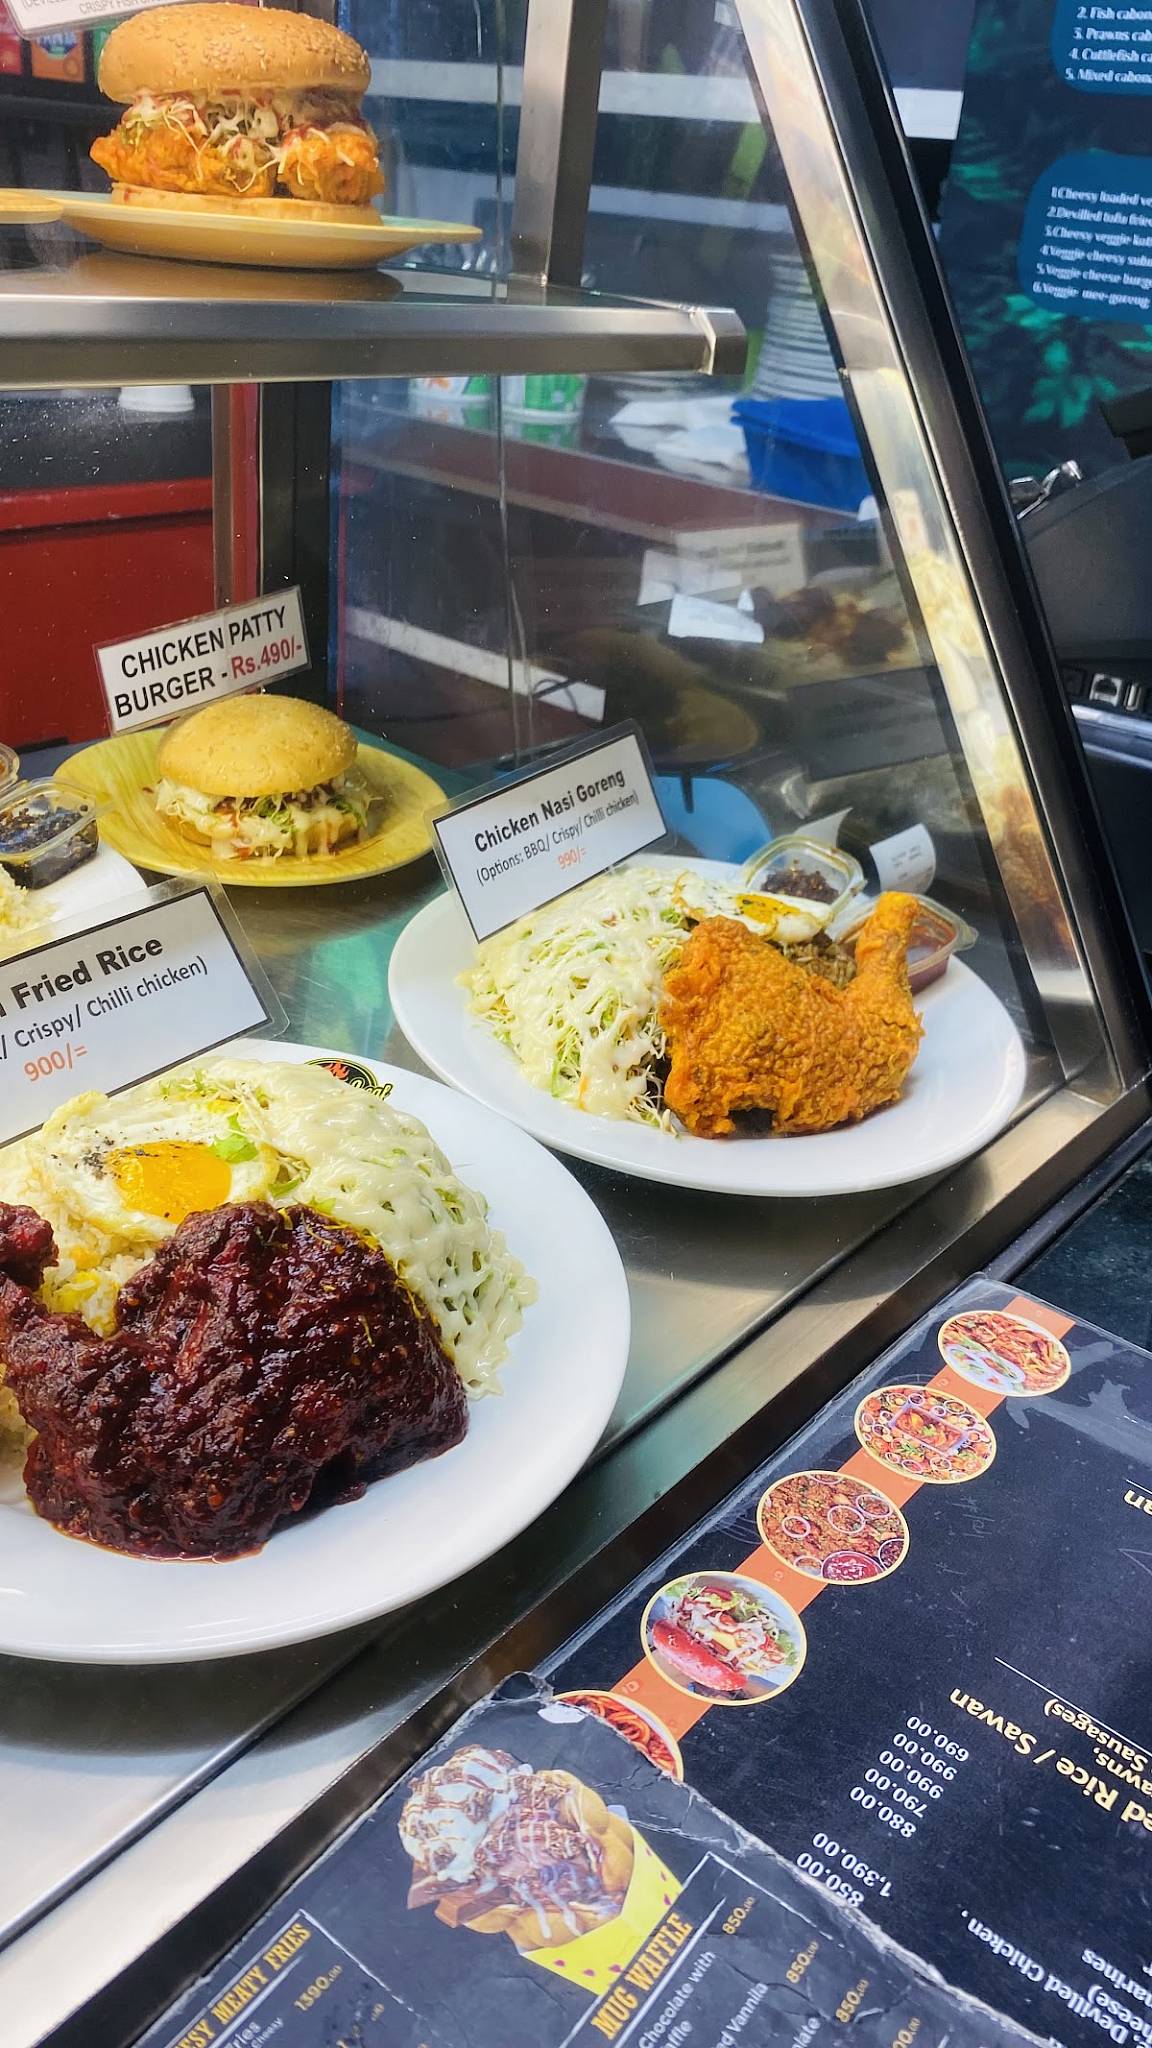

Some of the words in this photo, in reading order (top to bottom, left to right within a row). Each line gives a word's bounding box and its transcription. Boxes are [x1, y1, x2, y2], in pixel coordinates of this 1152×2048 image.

[121, 628, 225, 678] CHICKEN
[228, 606, 286, 646] PATTY
[114, 667, 216, 718] BURGER
[474, 812, 540, 852] Chicken
[541, 791, 576, 821] Nasi
[576, 770, 626, 803] Goreng
[476, 855, 524, 887] (Options:
[552, 816, 584, 845] Crispy/
[583, 808, 606, 829] Chilli
[606, 789, 640, 817] chicken)
[557, 846, 588, 871] 990/=
[11, 960, 93, 1010] Fried
[96, 937, 164, 976] Rice
[14, 1003, 82, 1048] Crispy/
[87, 986, 134, 1018] Chilli
[136, 955, 208, 997] chicken)
[24, 1042, 88, 1082] 900/=
[906, 1716, 969, 1762] 690.00
[949, 1688, 1038, 1755] Sawan
[1043, 1698, 1149, 1773] Sausages)
[878, 1750, 944, 1799] 990.00
[892, 1733, 958, 1781] 990.00
[1056, 1757, 1119, 1812] Rice
[849, 1786, 917, 1838] 880.00
[864, 1768, 928, 1818] 790.00
[796, 1852, 865, 1908] 850.00
[812, 1832, 893, 1897] 1,390.00
[211, 1966, 269, 2025] MEATY
[262, 1922, 312, 1970] FRIES
[591, 1986, 639, 2040] MUG
[624, 1913, 692, 1991] WAFFLE
[638, 1982, 694, 2048] Chocolate
[688, 1951, 716, 1983] with
[1043, 1974, 1130, 2044] Devilled
